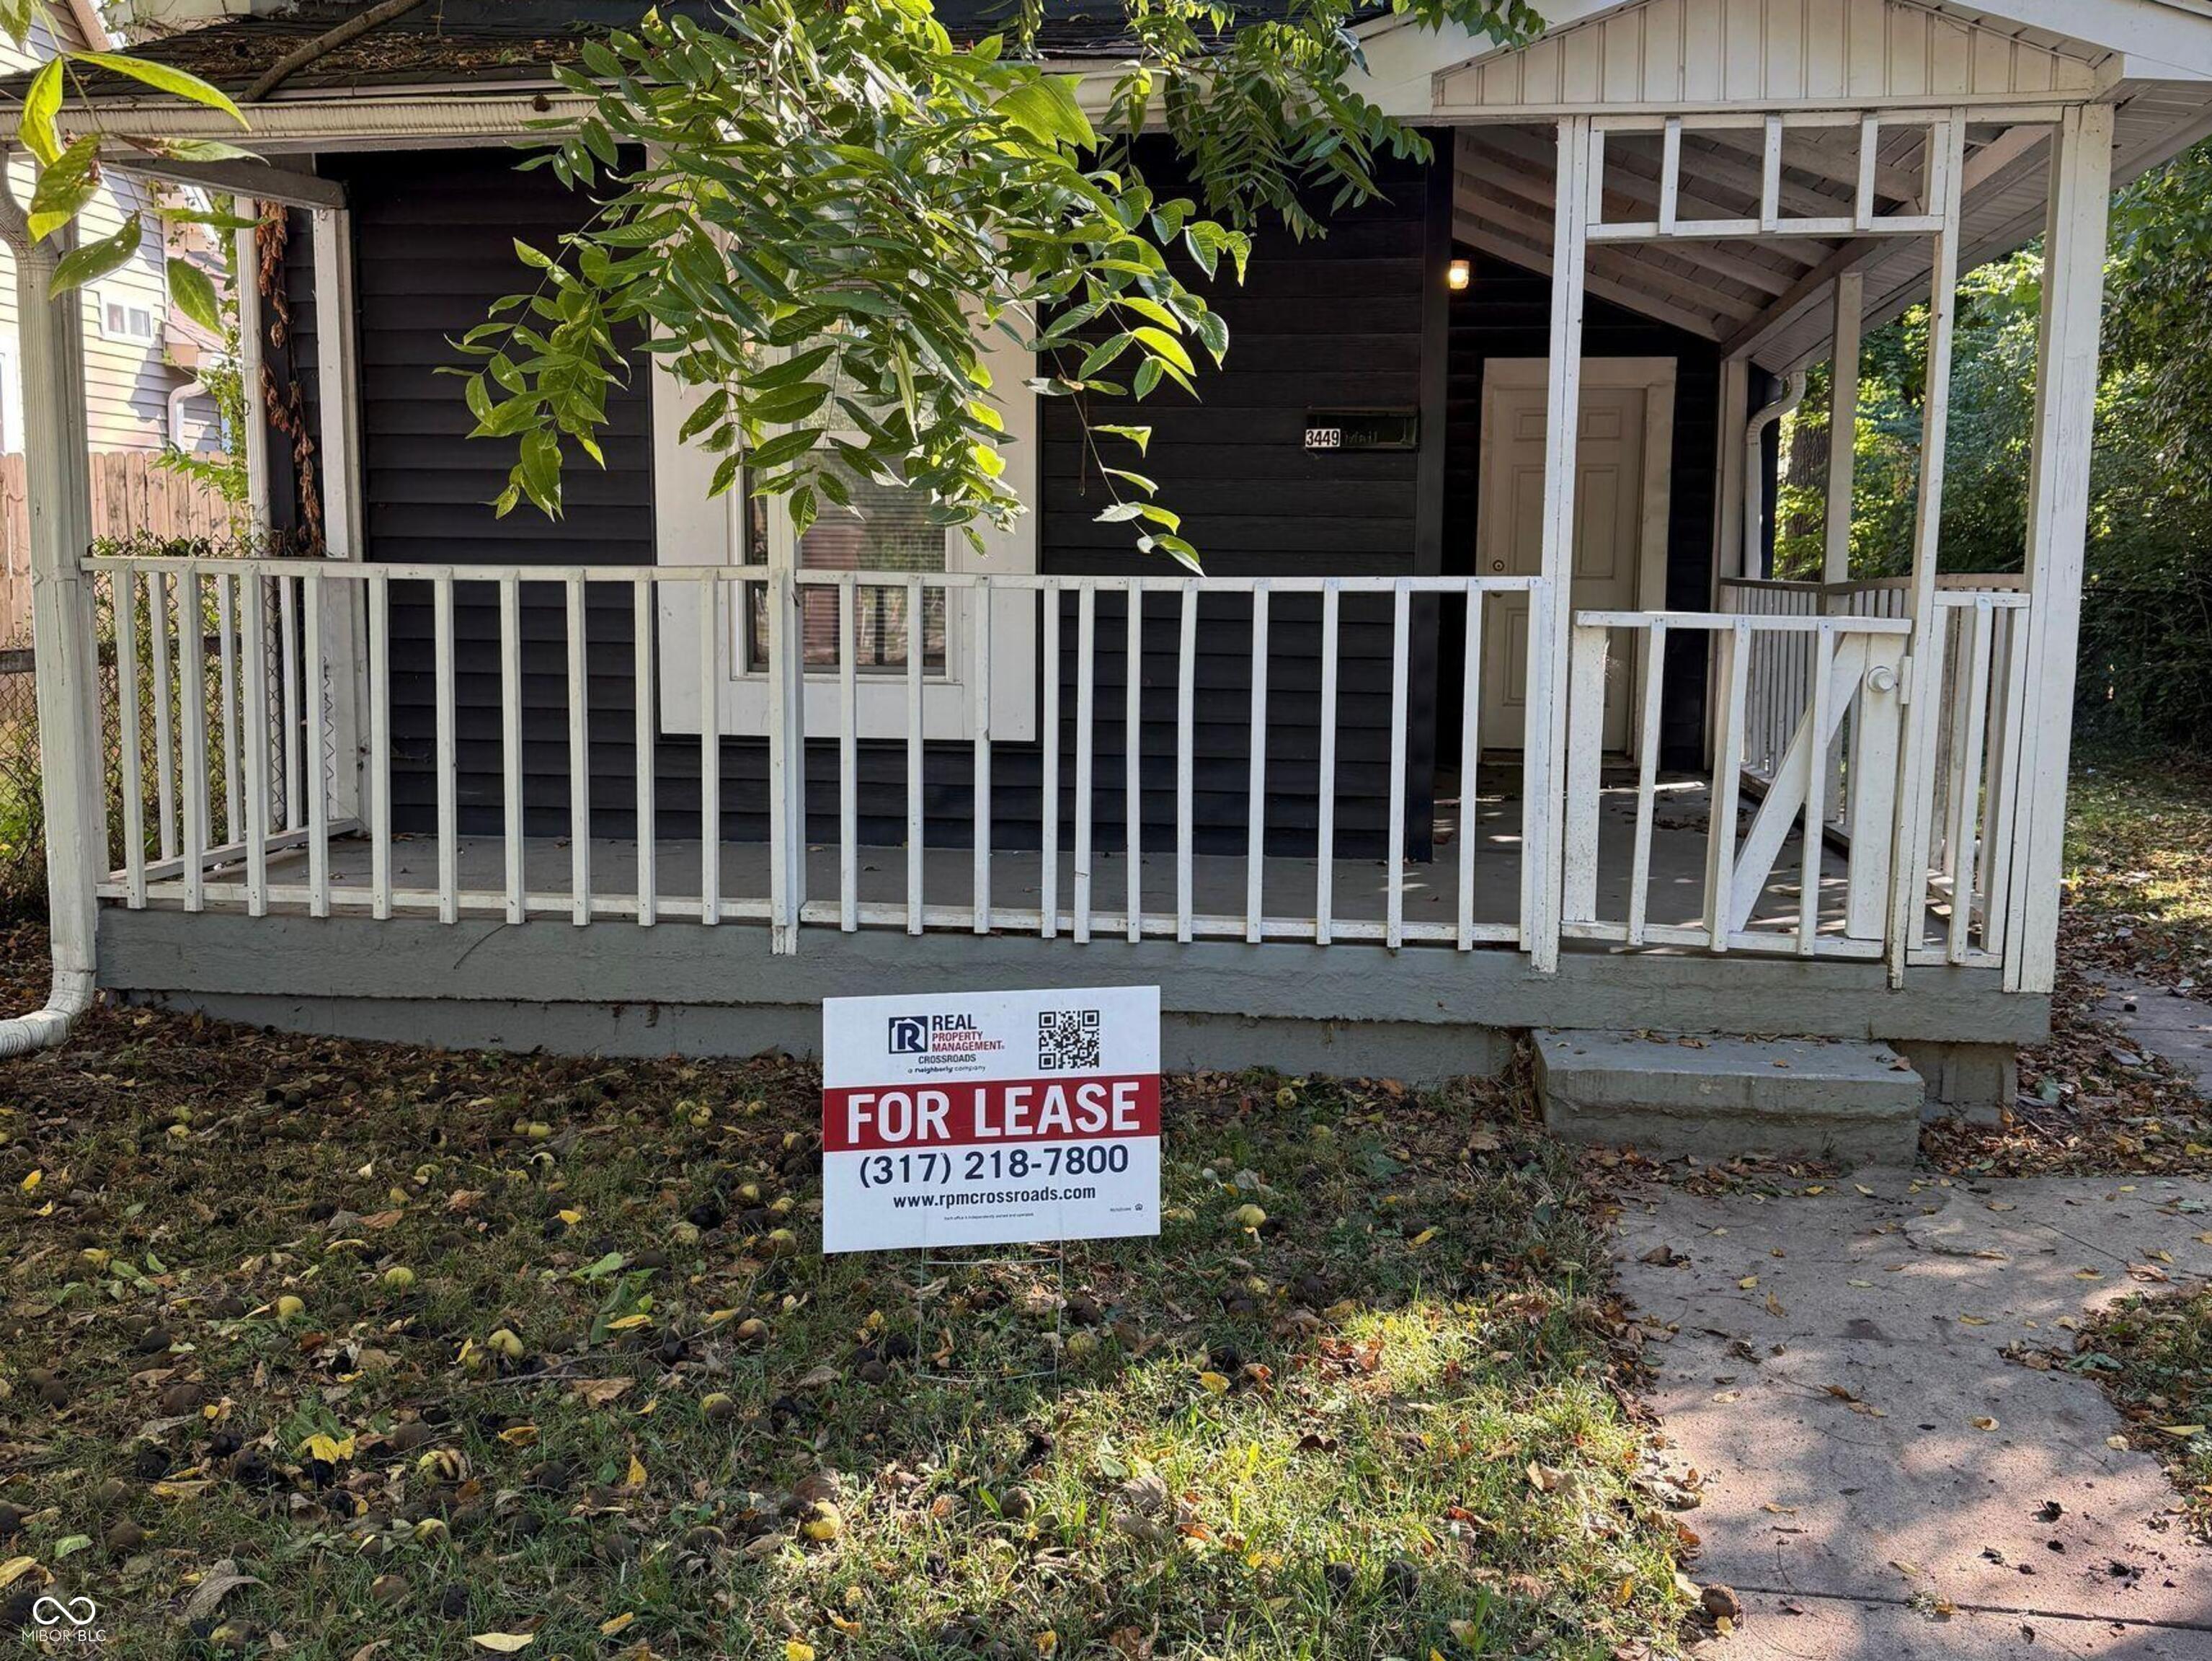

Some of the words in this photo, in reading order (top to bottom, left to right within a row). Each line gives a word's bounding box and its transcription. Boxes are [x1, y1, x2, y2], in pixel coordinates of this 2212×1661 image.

[1306, 430, 1340, 446] 3449
[932, 1014, 977, 1031] REAL
[932, 1031, 983, 1042] PROPERTY
[918, 1054, 977, 1064] CROSSROADS
[915, 1066, 953, 1074] neighborly
[847, 1090, 951, 1144] FOR
[974, 1081, 1140, 1138] LEASE
[860, 1152, 951, 1188] (317)
[964, 1144, 1129, 1180] 218-7800
[893, 1186, 1096, 1209] www.rpmcrossroads.com
